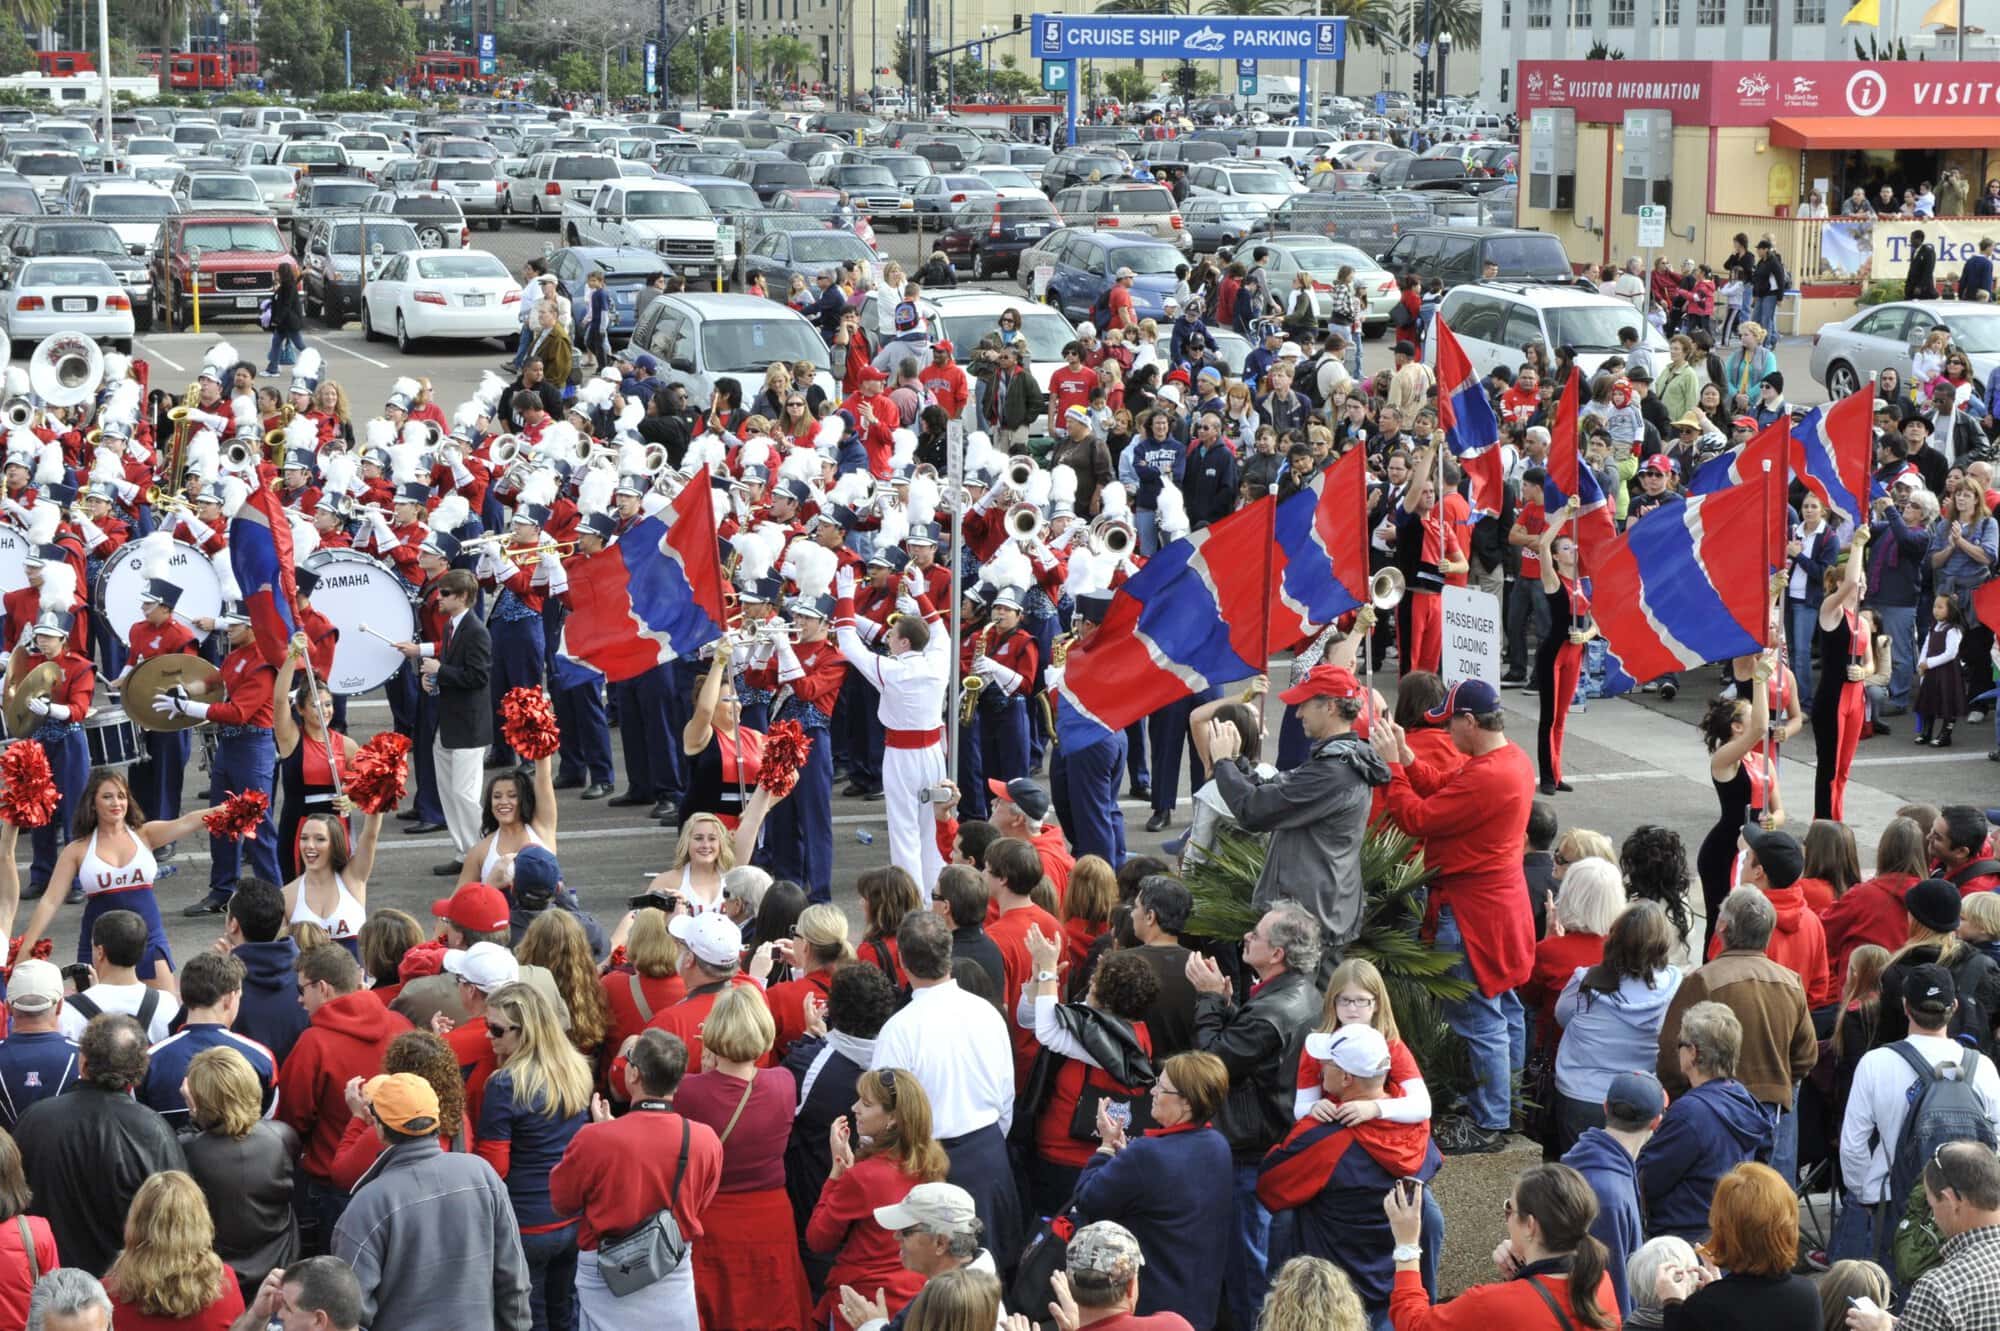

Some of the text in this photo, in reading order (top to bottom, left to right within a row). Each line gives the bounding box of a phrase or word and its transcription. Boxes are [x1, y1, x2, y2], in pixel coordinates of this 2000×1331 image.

[1046, 23, 1058, 40] 5
[1067, 28, 1135, 46] CRUISE
[1140, 29, 1181, 46] SHIP
[1233, 30, 1312, 47] PARKING
[1320, 25, 1333, 43] 5
[482, 34, 493, 50] 5
[483, 60, 493, 73] P
[1049, 65, 1065, 86] P
[1242, 79, 1253, 92] P
[1569, 81, 1613, 98] VISITOR
[1617, 82, 1701, 100] INFORMATION
[1913, 82, 2000, 105] VISIT
[325, 573, 370, 590] YAMAHA
[1446, 610, 1495, 634] PASSENGER
[1452, 635, 1488, 656] LOADING
[1459, 659, 1481, 677] ZONE
[97, 868, 145, 889] U of A
[336, 919, 350, 935] A
